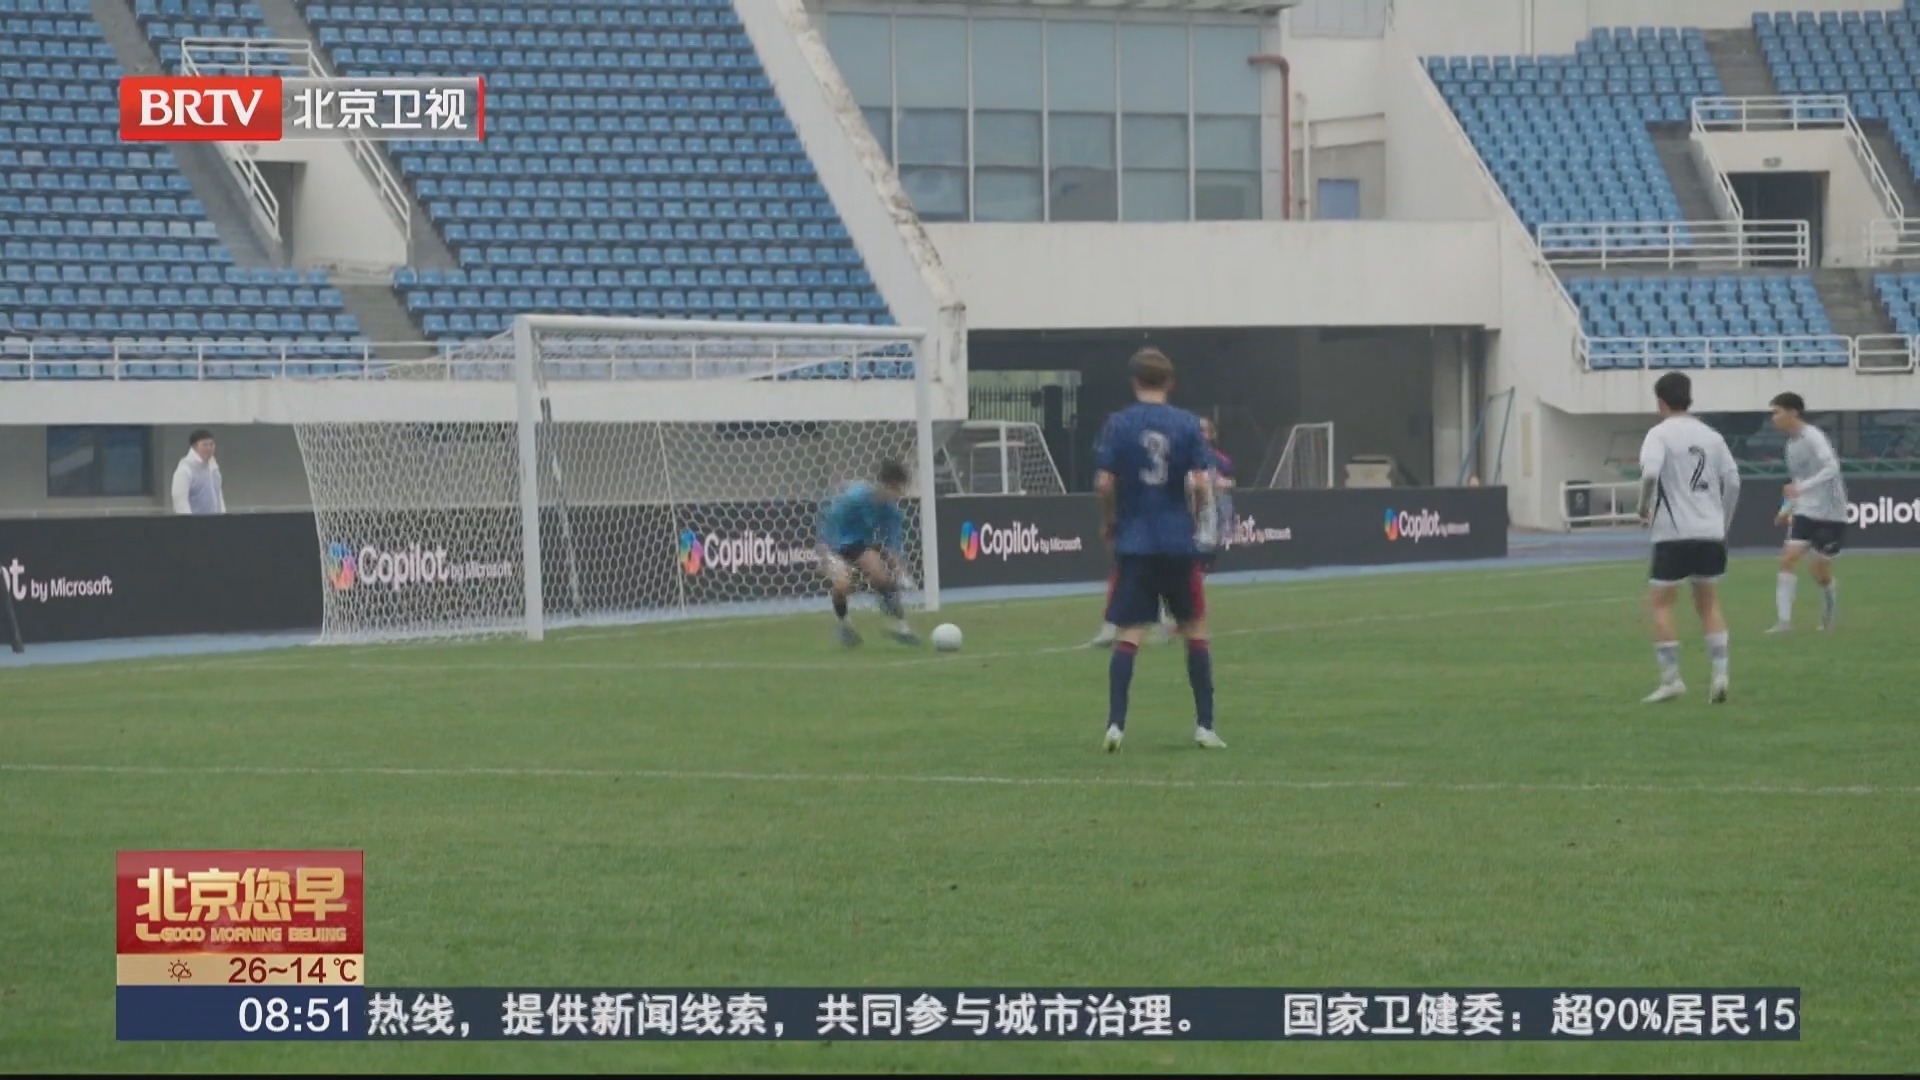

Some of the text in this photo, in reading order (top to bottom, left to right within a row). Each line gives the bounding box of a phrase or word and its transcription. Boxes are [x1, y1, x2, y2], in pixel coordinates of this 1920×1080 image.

[1139, 430, 1169, 485] 3
[1688, 446, 1709, 492] 2
[1399, 508, 1440, 543] Copilot
[1844, 496, 1920, 529] opilot
[704, 528, 775, 573] Copilot
[980, 521, 1039, 561] Copilot
[358, 543, 450, 590] Copilot
[31, 578, 48, 603] by
[50, 575, 113, 598] Microsoft
